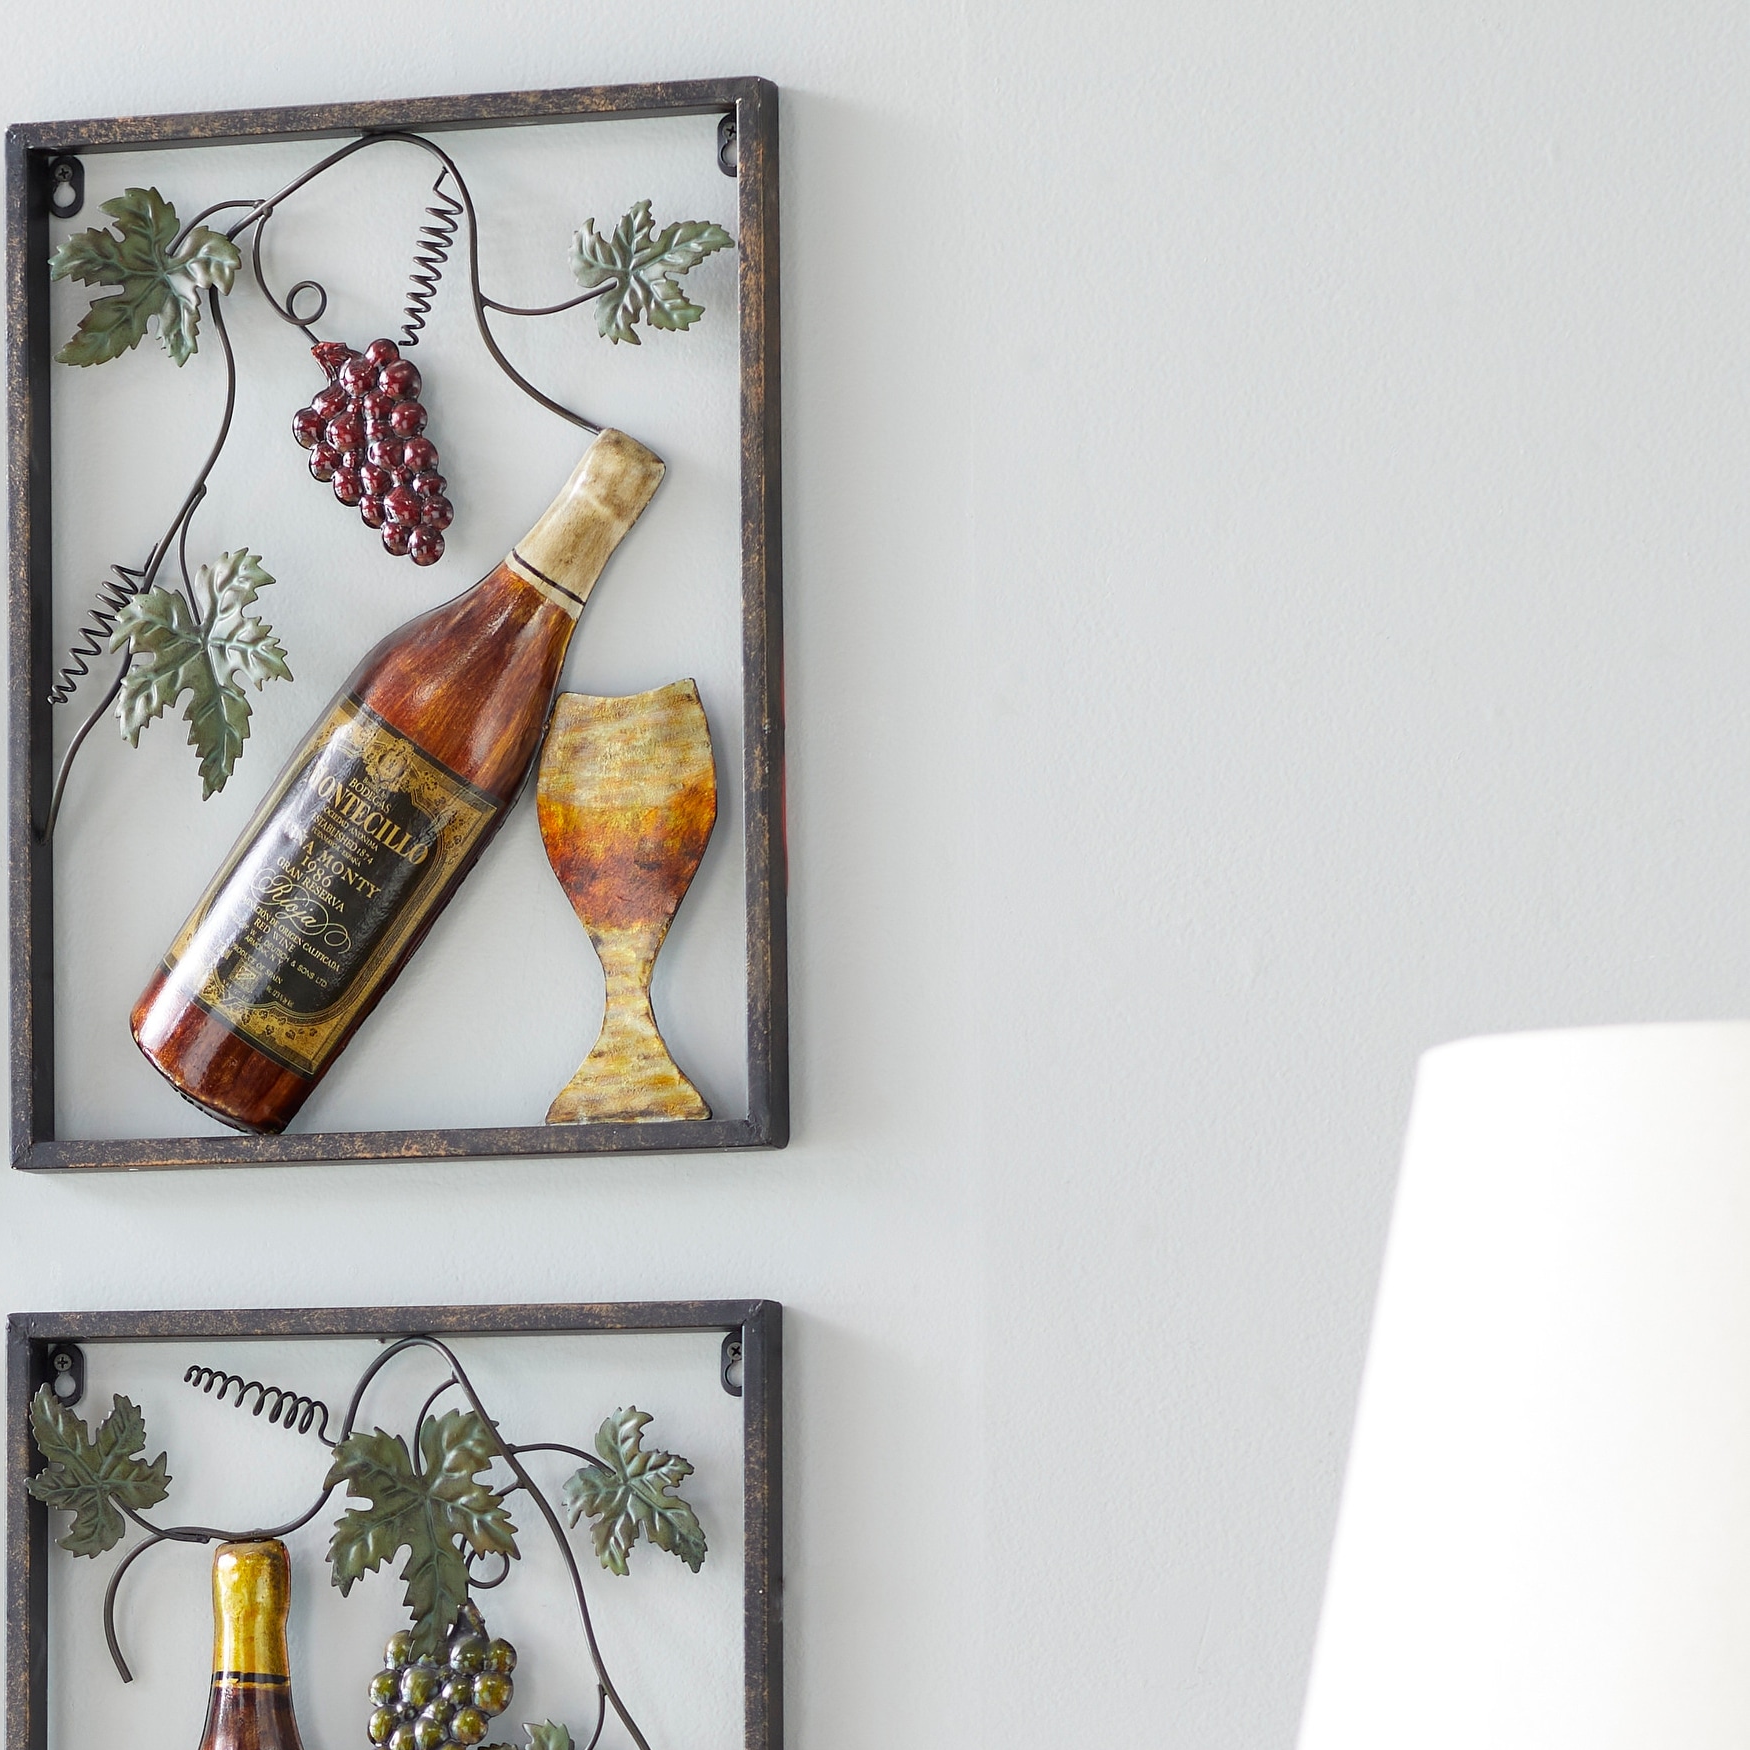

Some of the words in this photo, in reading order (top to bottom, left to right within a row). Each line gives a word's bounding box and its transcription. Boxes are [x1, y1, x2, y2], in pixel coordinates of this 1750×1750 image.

[348, 777, 393, 814] BODEGAS
[310, 811, 359, 852] ESTABLISHED
[355, 846, 374, 865] 1874
[275, 855, 303, 882] GRAN
[301, 875, 346, 913] RESERVA
[299, 854, 335, 889] 1986
[316, 849, 381, 898] MONTY
[253, 917, 271, 934] RED
[270, 930, 295, 953] WINE
[268, 917, 279, 928] DE
[276, 924, 302, 946] ORIGEN
[301, 942, 340, 972] CALIFICADA
[262, 939, 290, 962] DEUTSCH
[296, 963, 315, 981] SONS
